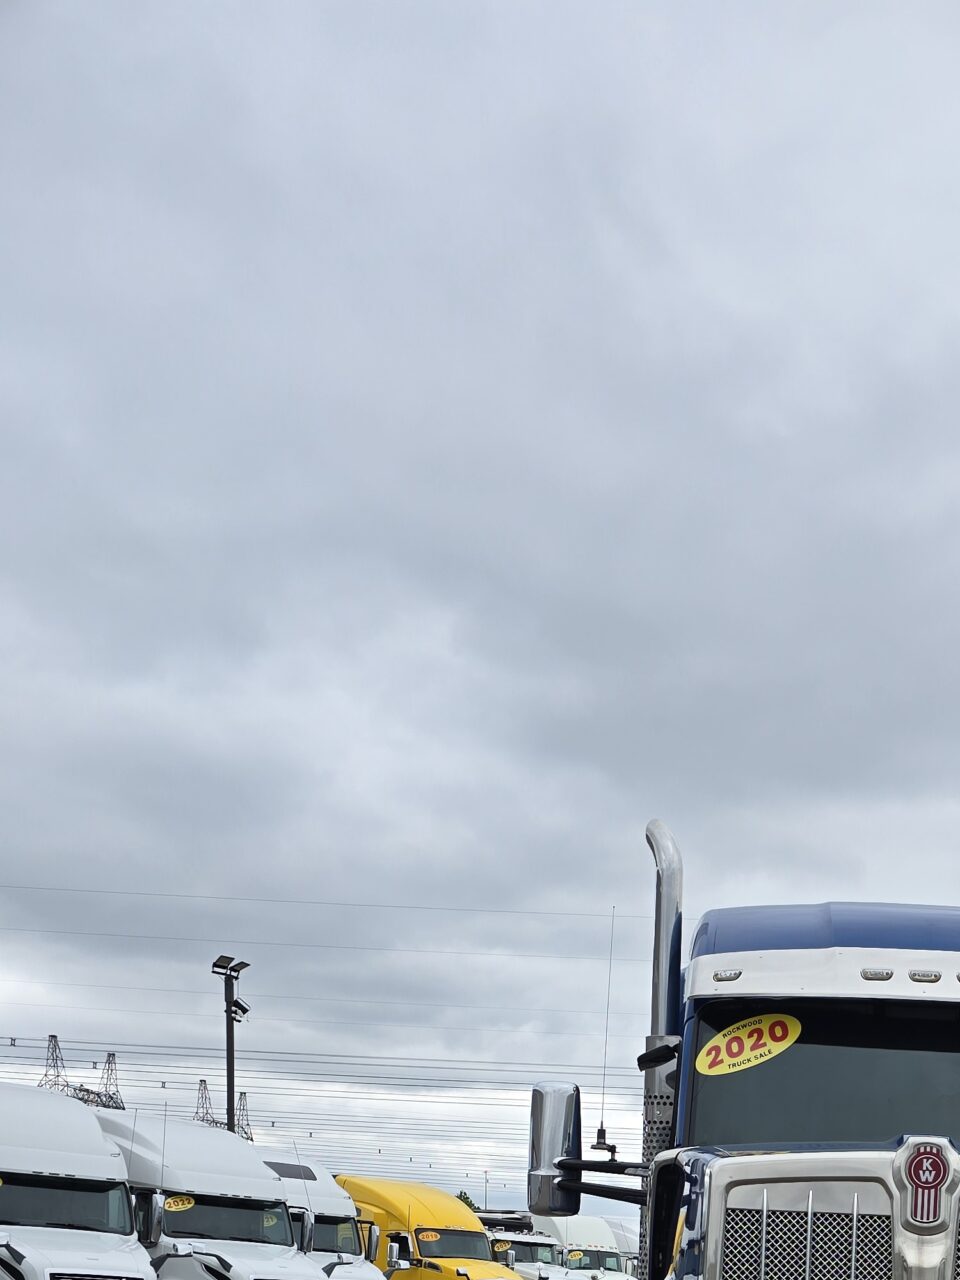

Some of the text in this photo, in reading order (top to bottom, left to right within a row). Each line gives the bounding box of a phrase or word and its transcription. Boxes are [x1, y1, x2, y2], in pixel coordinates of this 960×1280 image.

[722, 1018, 763, 1039] ROCKWOOD
[705, 1019, 789, 1070] 2020
[727, 1048, 774, 1070] TRUCK SALE
[166, 1198, 193, 1209] 2022
